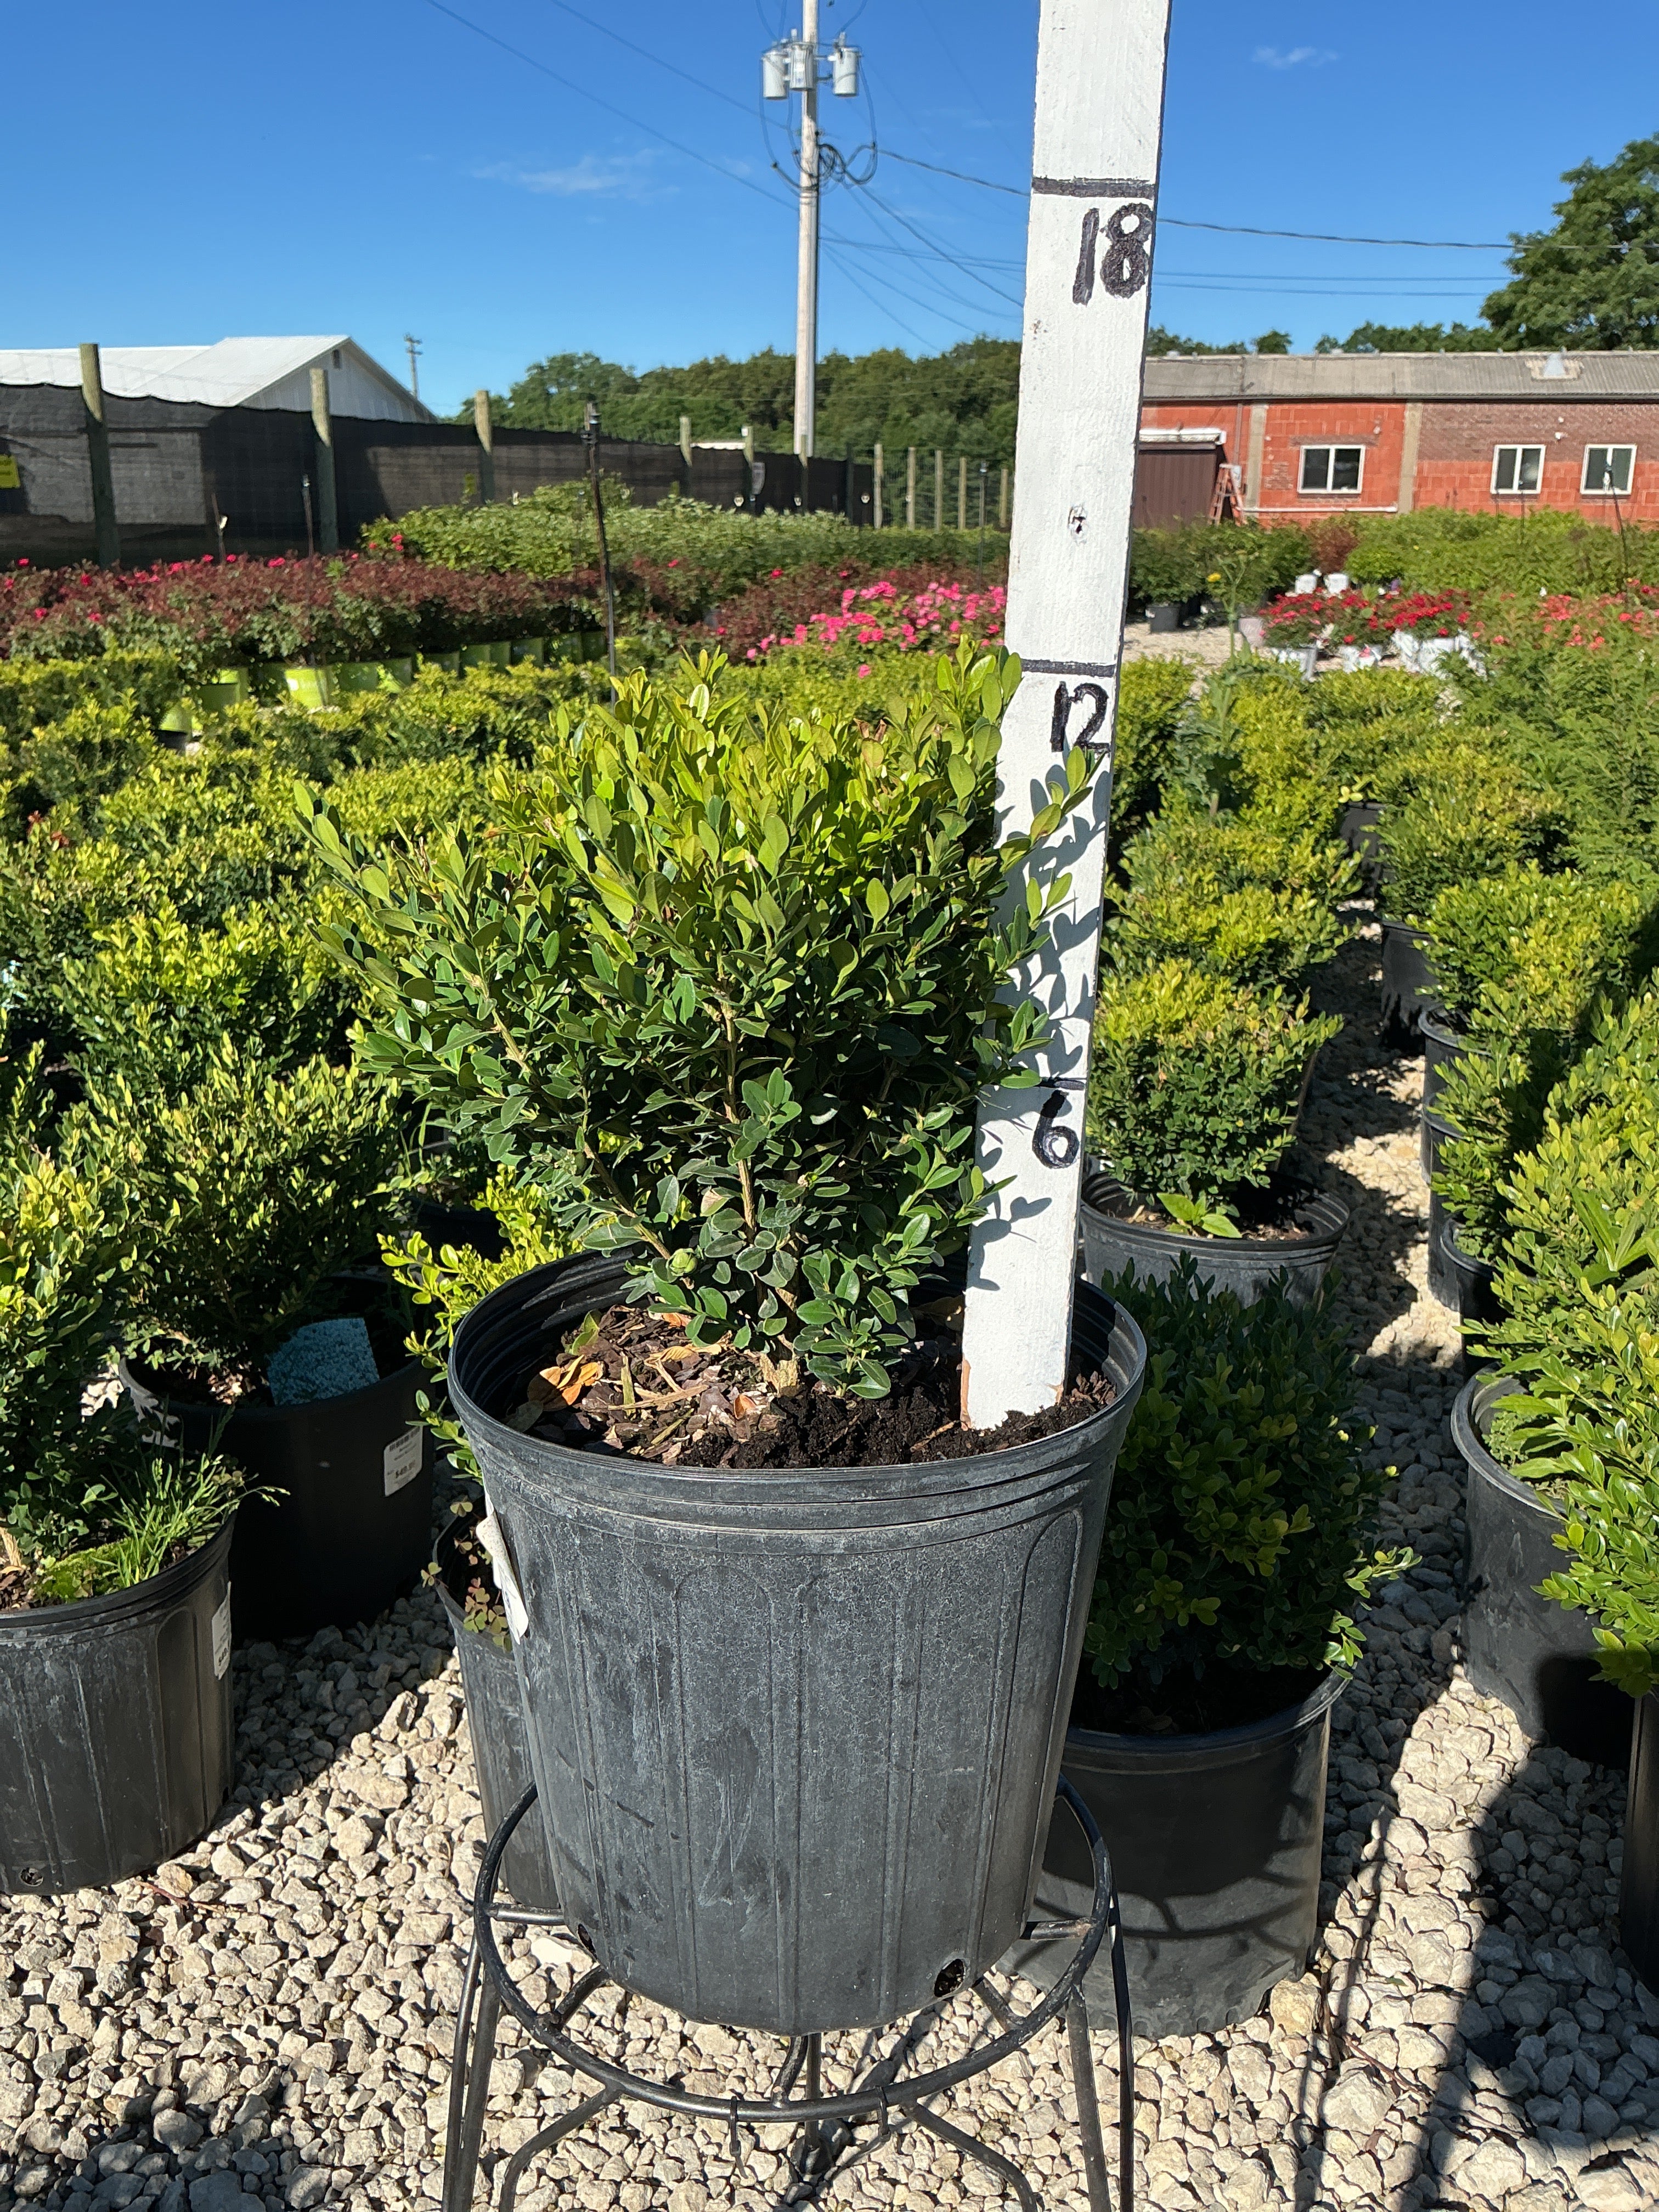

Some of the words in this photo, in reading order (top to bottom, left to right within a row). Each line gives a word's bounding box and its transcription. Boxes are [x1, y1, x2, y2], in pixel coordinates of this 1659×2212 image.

[1073, 202, 1153, 306] 18
[1050, 681, 1110, 753] 12
[1032, 1090, 1080, 1169] 6
